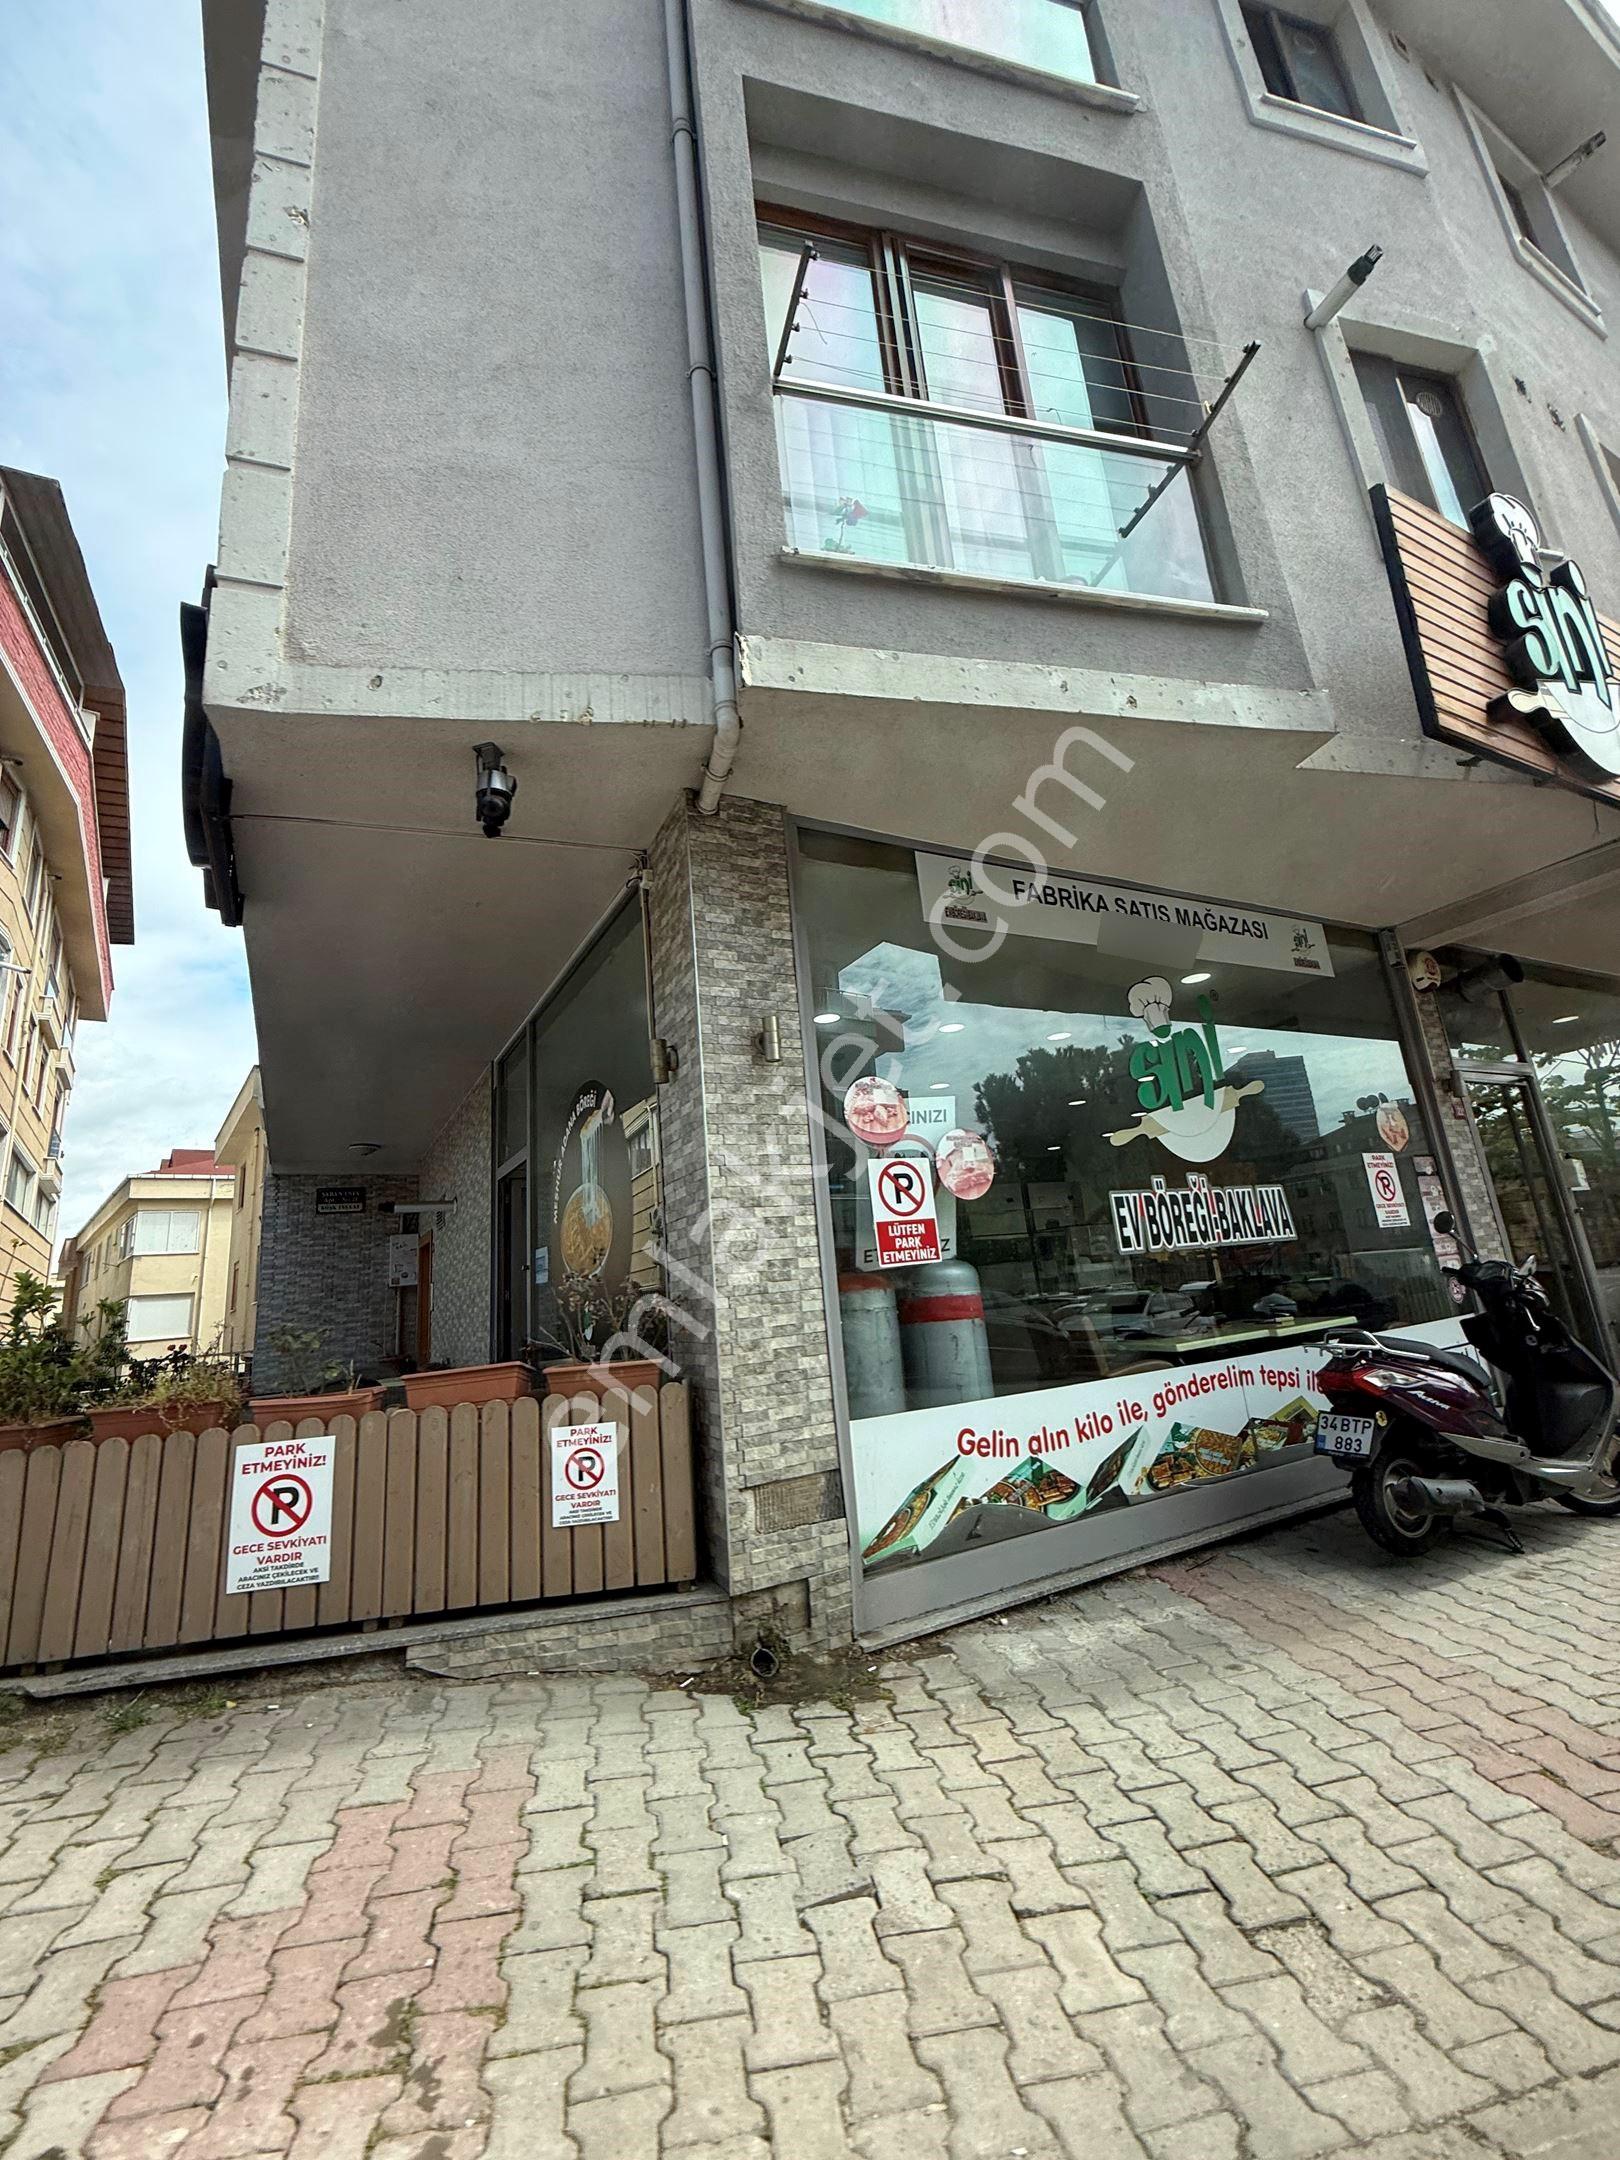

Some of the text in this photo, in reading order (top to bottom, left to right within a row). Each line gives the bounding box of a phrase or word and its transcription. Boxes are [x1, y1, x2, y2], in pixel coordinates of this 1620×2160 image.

[1012, 880, 1109, 913] FABRİKA
[1175, 907, 1269, 940] MAĞAZASI
[576, 1090, 598, 1117] BÖREĞİ
[888, 1223, 926, 1236] LÜTFEN
[1112, 1195, 1143, 1249] EV
[895, 1236, 922, 1249] PARK
[883, 1245, 937, 1263] ETMEYİNİZ
[957, 1428, 1019, 1458] Gelin
[1028, 1426, 1070, 1456] alın
[1074, 1411, 1113, 1443] kilo
[1116, 1399, 1149, 1426] ile,
[1153, 1364, 1255, 1418] gönderelim
[1259, 1364, 1300, 1392] tepsi
[571, 1427, 598, 1436] PARK
[1341, 1418, 1372, 1434] BTP
[557, 1433, 612, 1448] ETMEYİNİZ!
[1334, 1436, 1363, 1452] 883
[265, 1442, 305, 1458] PARK
[242, 1454, 327, 1475] ETMEYİNİZ!
[233, 1536, 327, 1555] GECE SEVKİYATI
[257, 1552, 303, 1565] VARDIR
